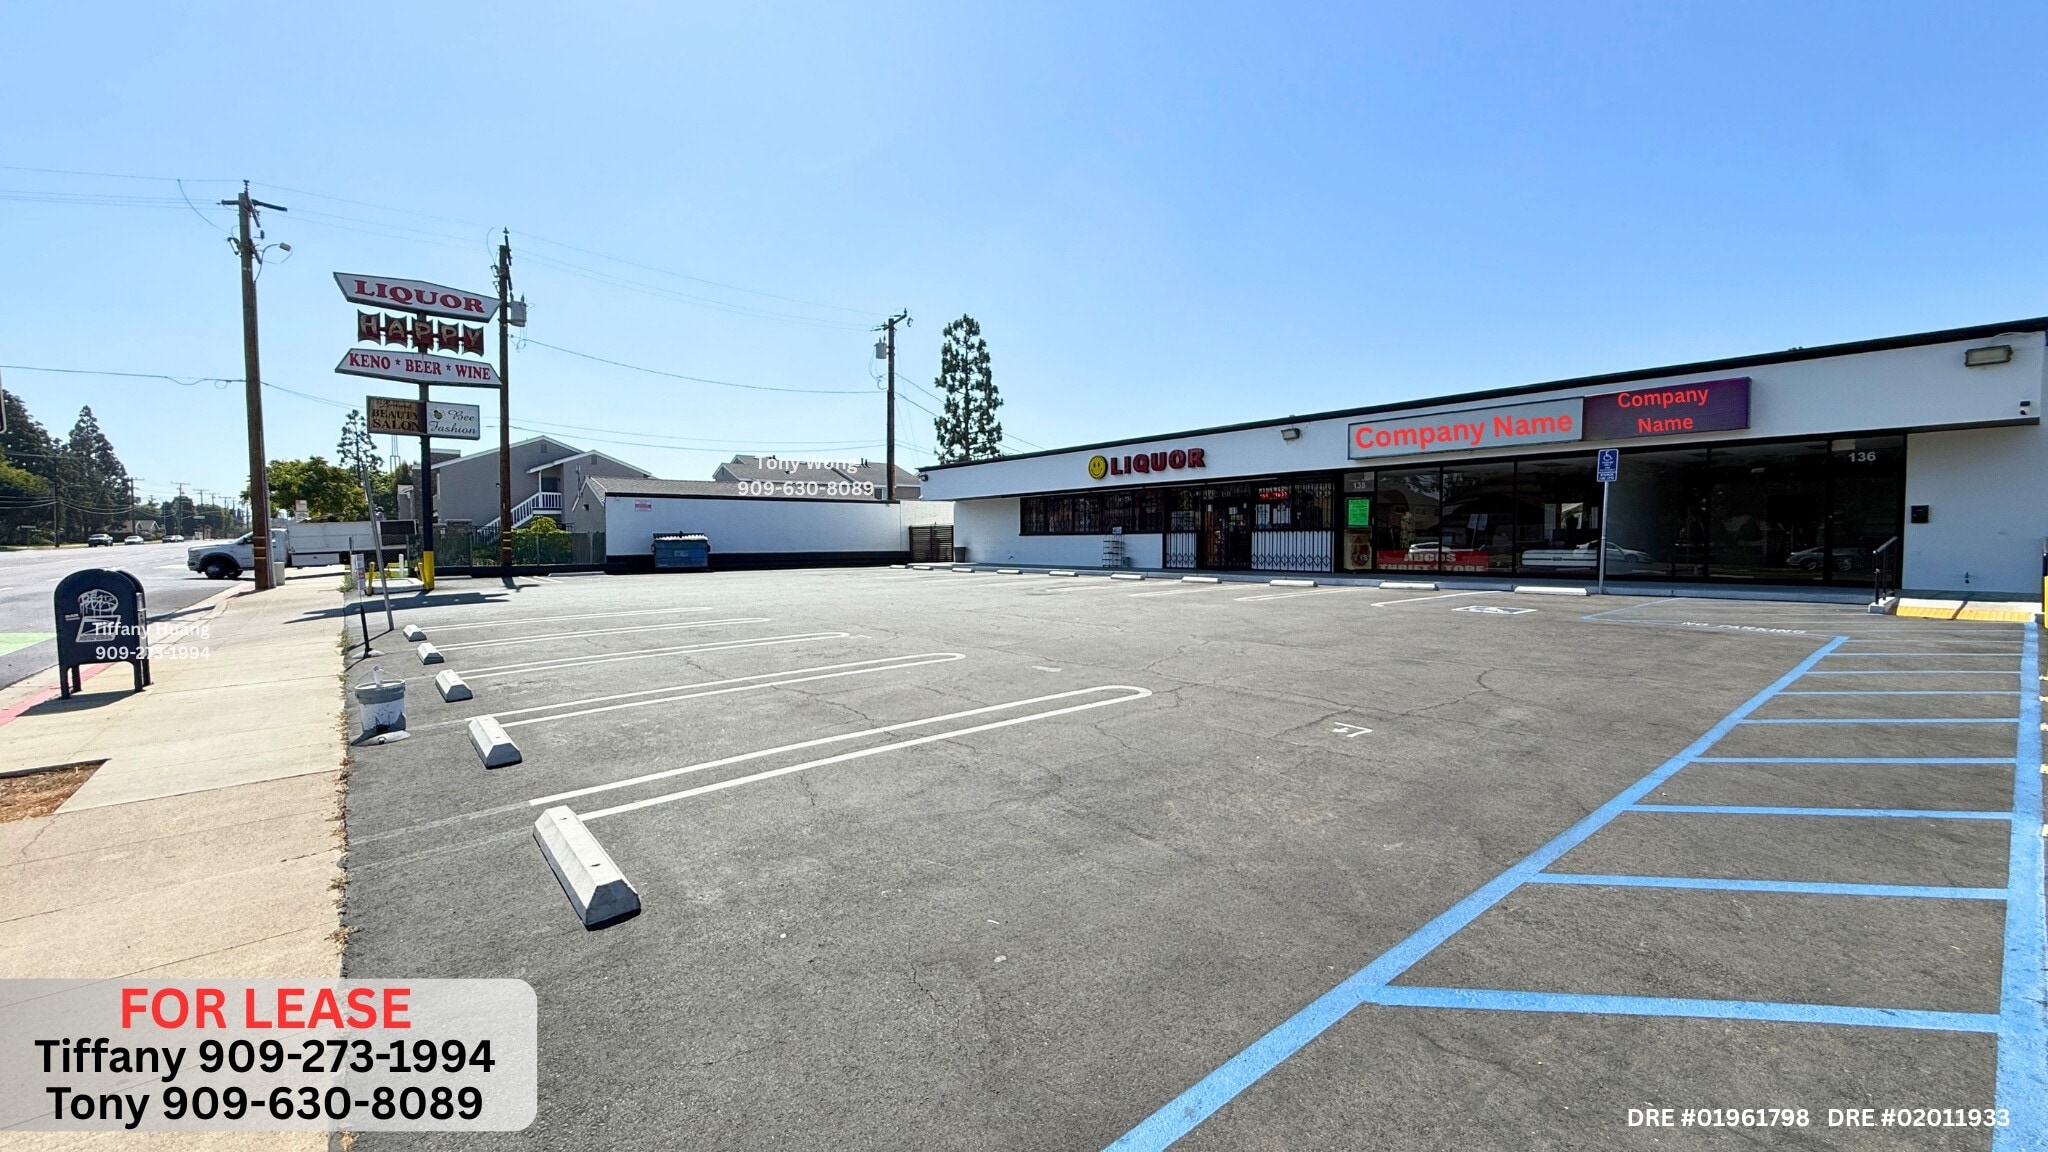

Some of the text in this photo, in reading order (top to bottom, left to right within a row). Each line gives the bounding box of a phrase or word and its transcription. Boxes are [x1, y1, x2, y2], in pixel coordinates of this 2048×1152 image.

[354, 279, 485, 313] LIQUOR
[359, 313, 482, 347] HAPPY
[349, 353, 491, 381] KENO BEER WINE
[371, 408, 418, 420] BEAUTY
[448, 409, 475, 421] Bee
[372, 418, 422, 433] SALON
[428, 420, 477, 435] Fashion
[1110, 447, 1206, 476] LIQUOR
[1848, 451, 1877, 463] 136
